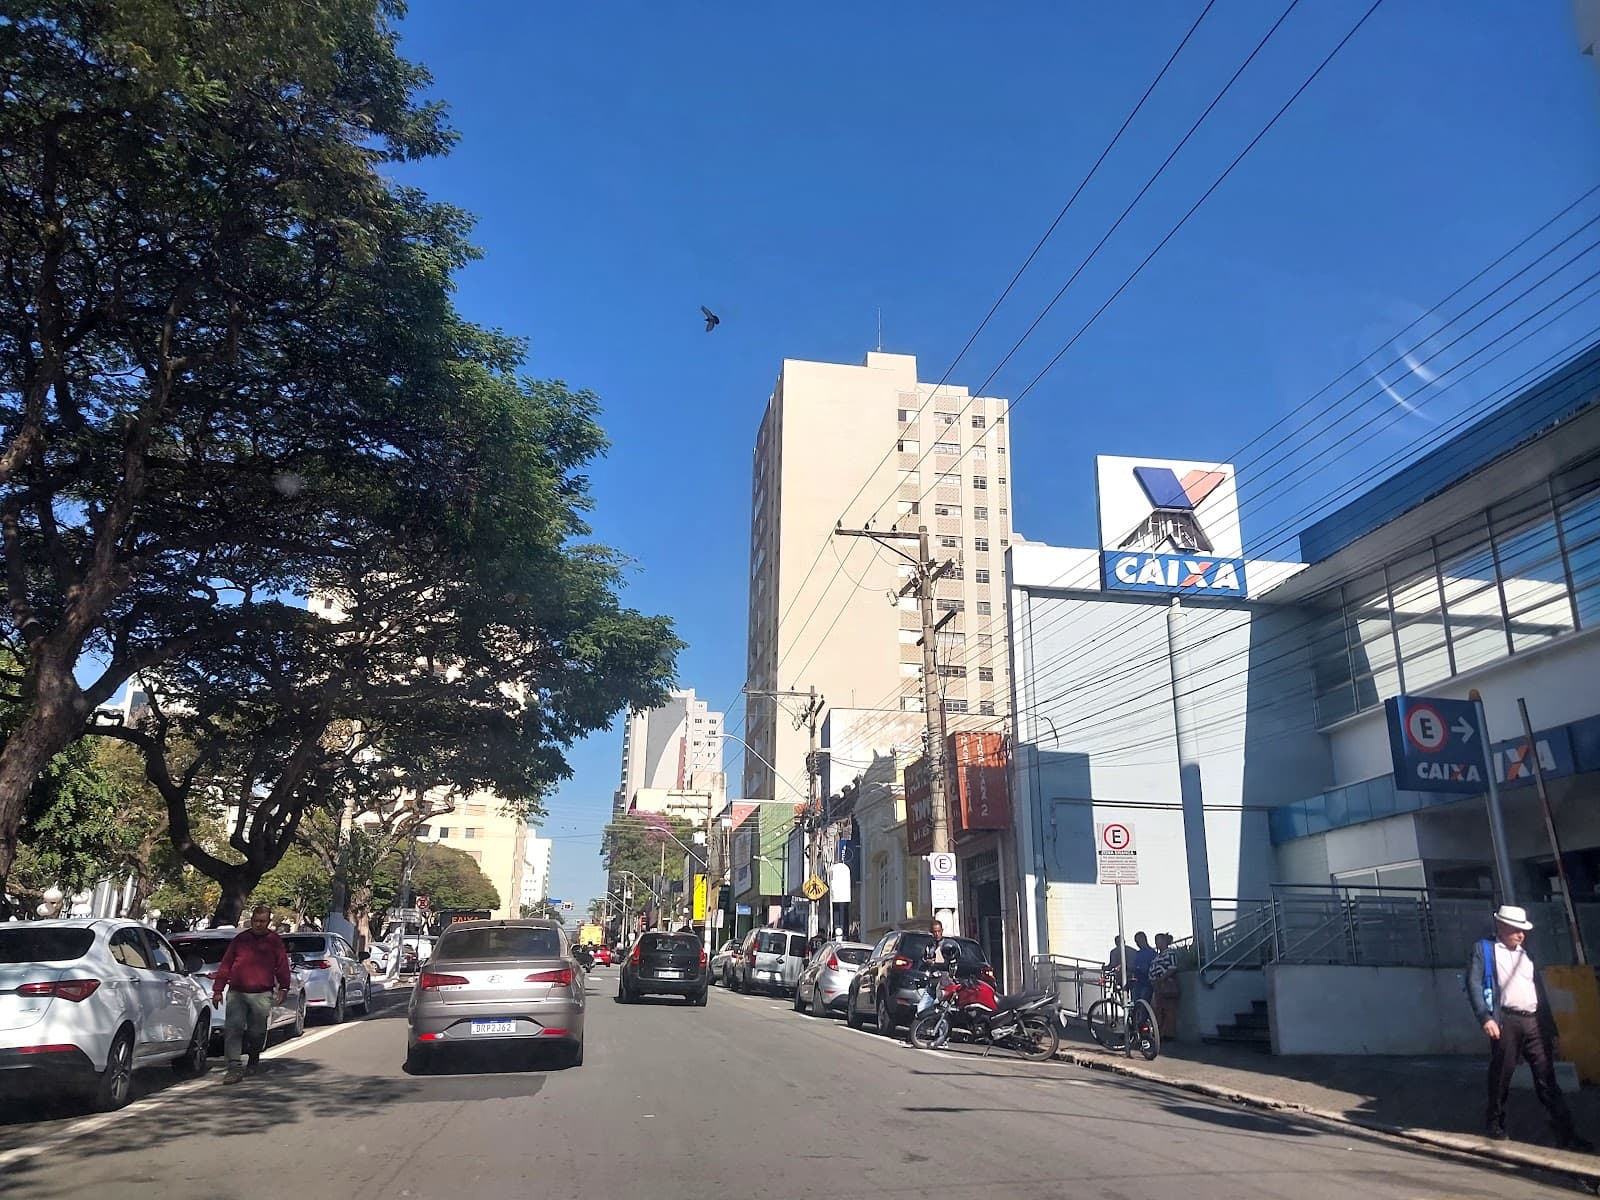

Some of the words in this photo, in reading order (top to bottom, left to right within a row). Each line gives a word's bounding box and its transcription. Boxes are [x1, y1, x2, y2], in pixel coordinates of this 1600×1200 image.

[1115, 556, 1240, 590] CAIXA
[1420, 717, 1434, 739] E
[1417, 761, 1480, 782] CAIXA
[1112, 830, 1121, 843] E
[939, 859, 947, 869] E
